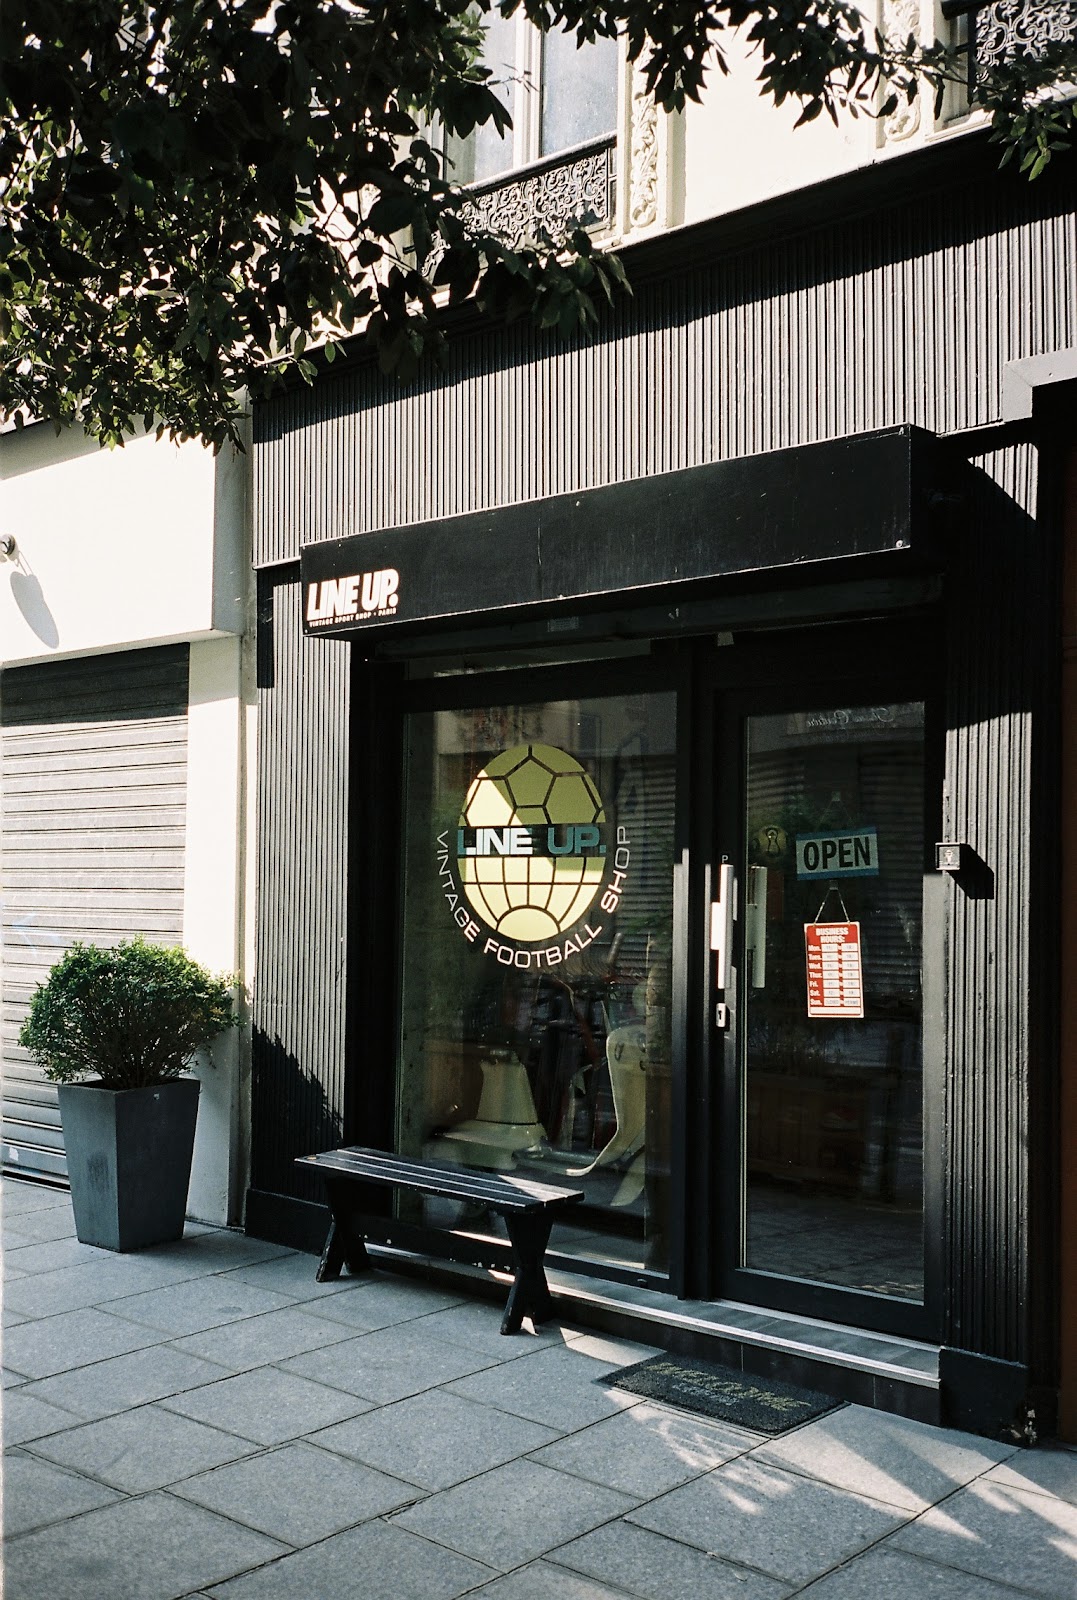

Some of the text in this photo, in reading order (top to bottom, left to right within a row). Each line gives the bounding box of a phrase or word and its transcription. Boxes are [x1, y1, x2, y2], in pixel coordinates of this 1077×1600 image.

[307, 568, 399, 621] LINE UP.
[309, 607, 397, 628] VINTAGE SPORT SHOP PARIS
[457, 826, 607, 856] LINE UP.
[803, 835, 871, 871] OPEN
[436, 825, 631, 969] VINTAGE FOOTBALL SHOP
[815, 927, 849, 936] BUSINESS
[820, 935, 846, 944] HOURS:
[808, 944, 821, 952] Mon.
